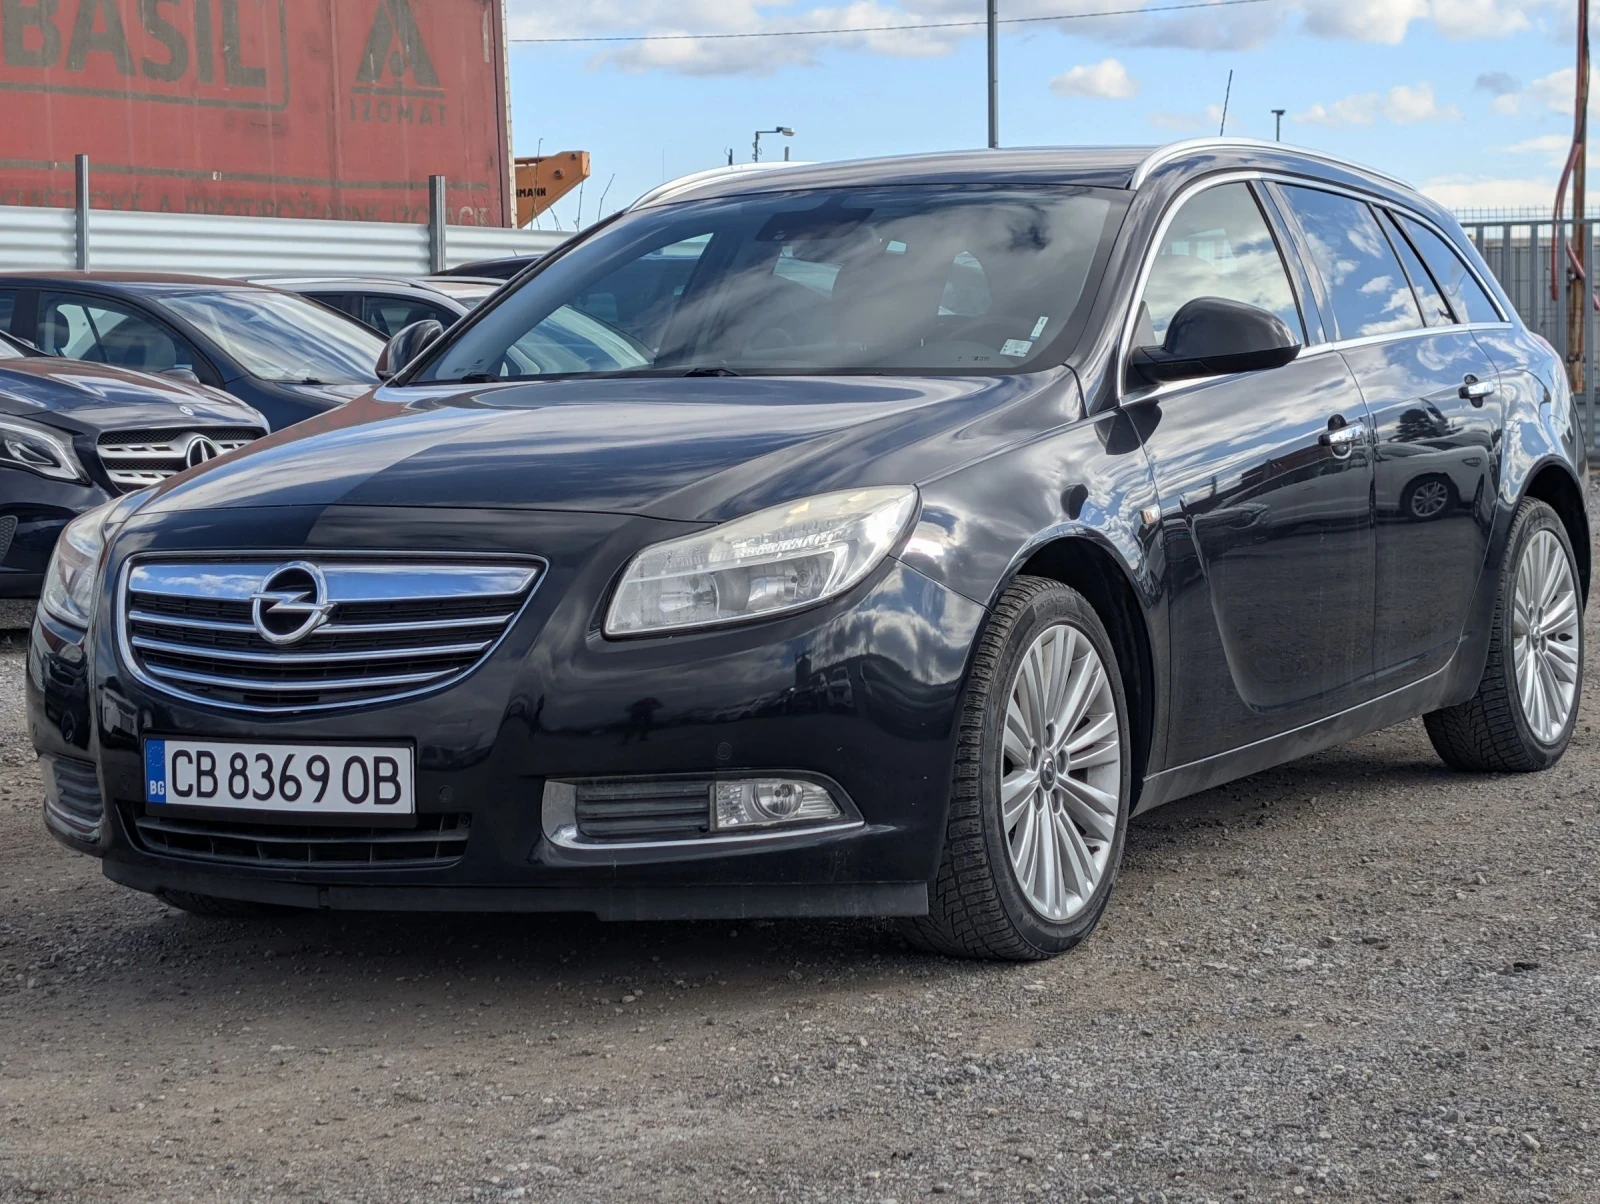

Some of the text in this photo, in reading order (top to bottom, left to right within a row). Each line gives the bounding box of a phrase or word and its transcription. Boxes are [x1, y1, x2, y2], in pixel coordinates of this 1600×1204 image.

[349, 98, 448, 127] IZOMAT
[149, 779, 165, 795] BG
[171, 749, 219, 798] CB
[228, 752, 331, 804] 8369
